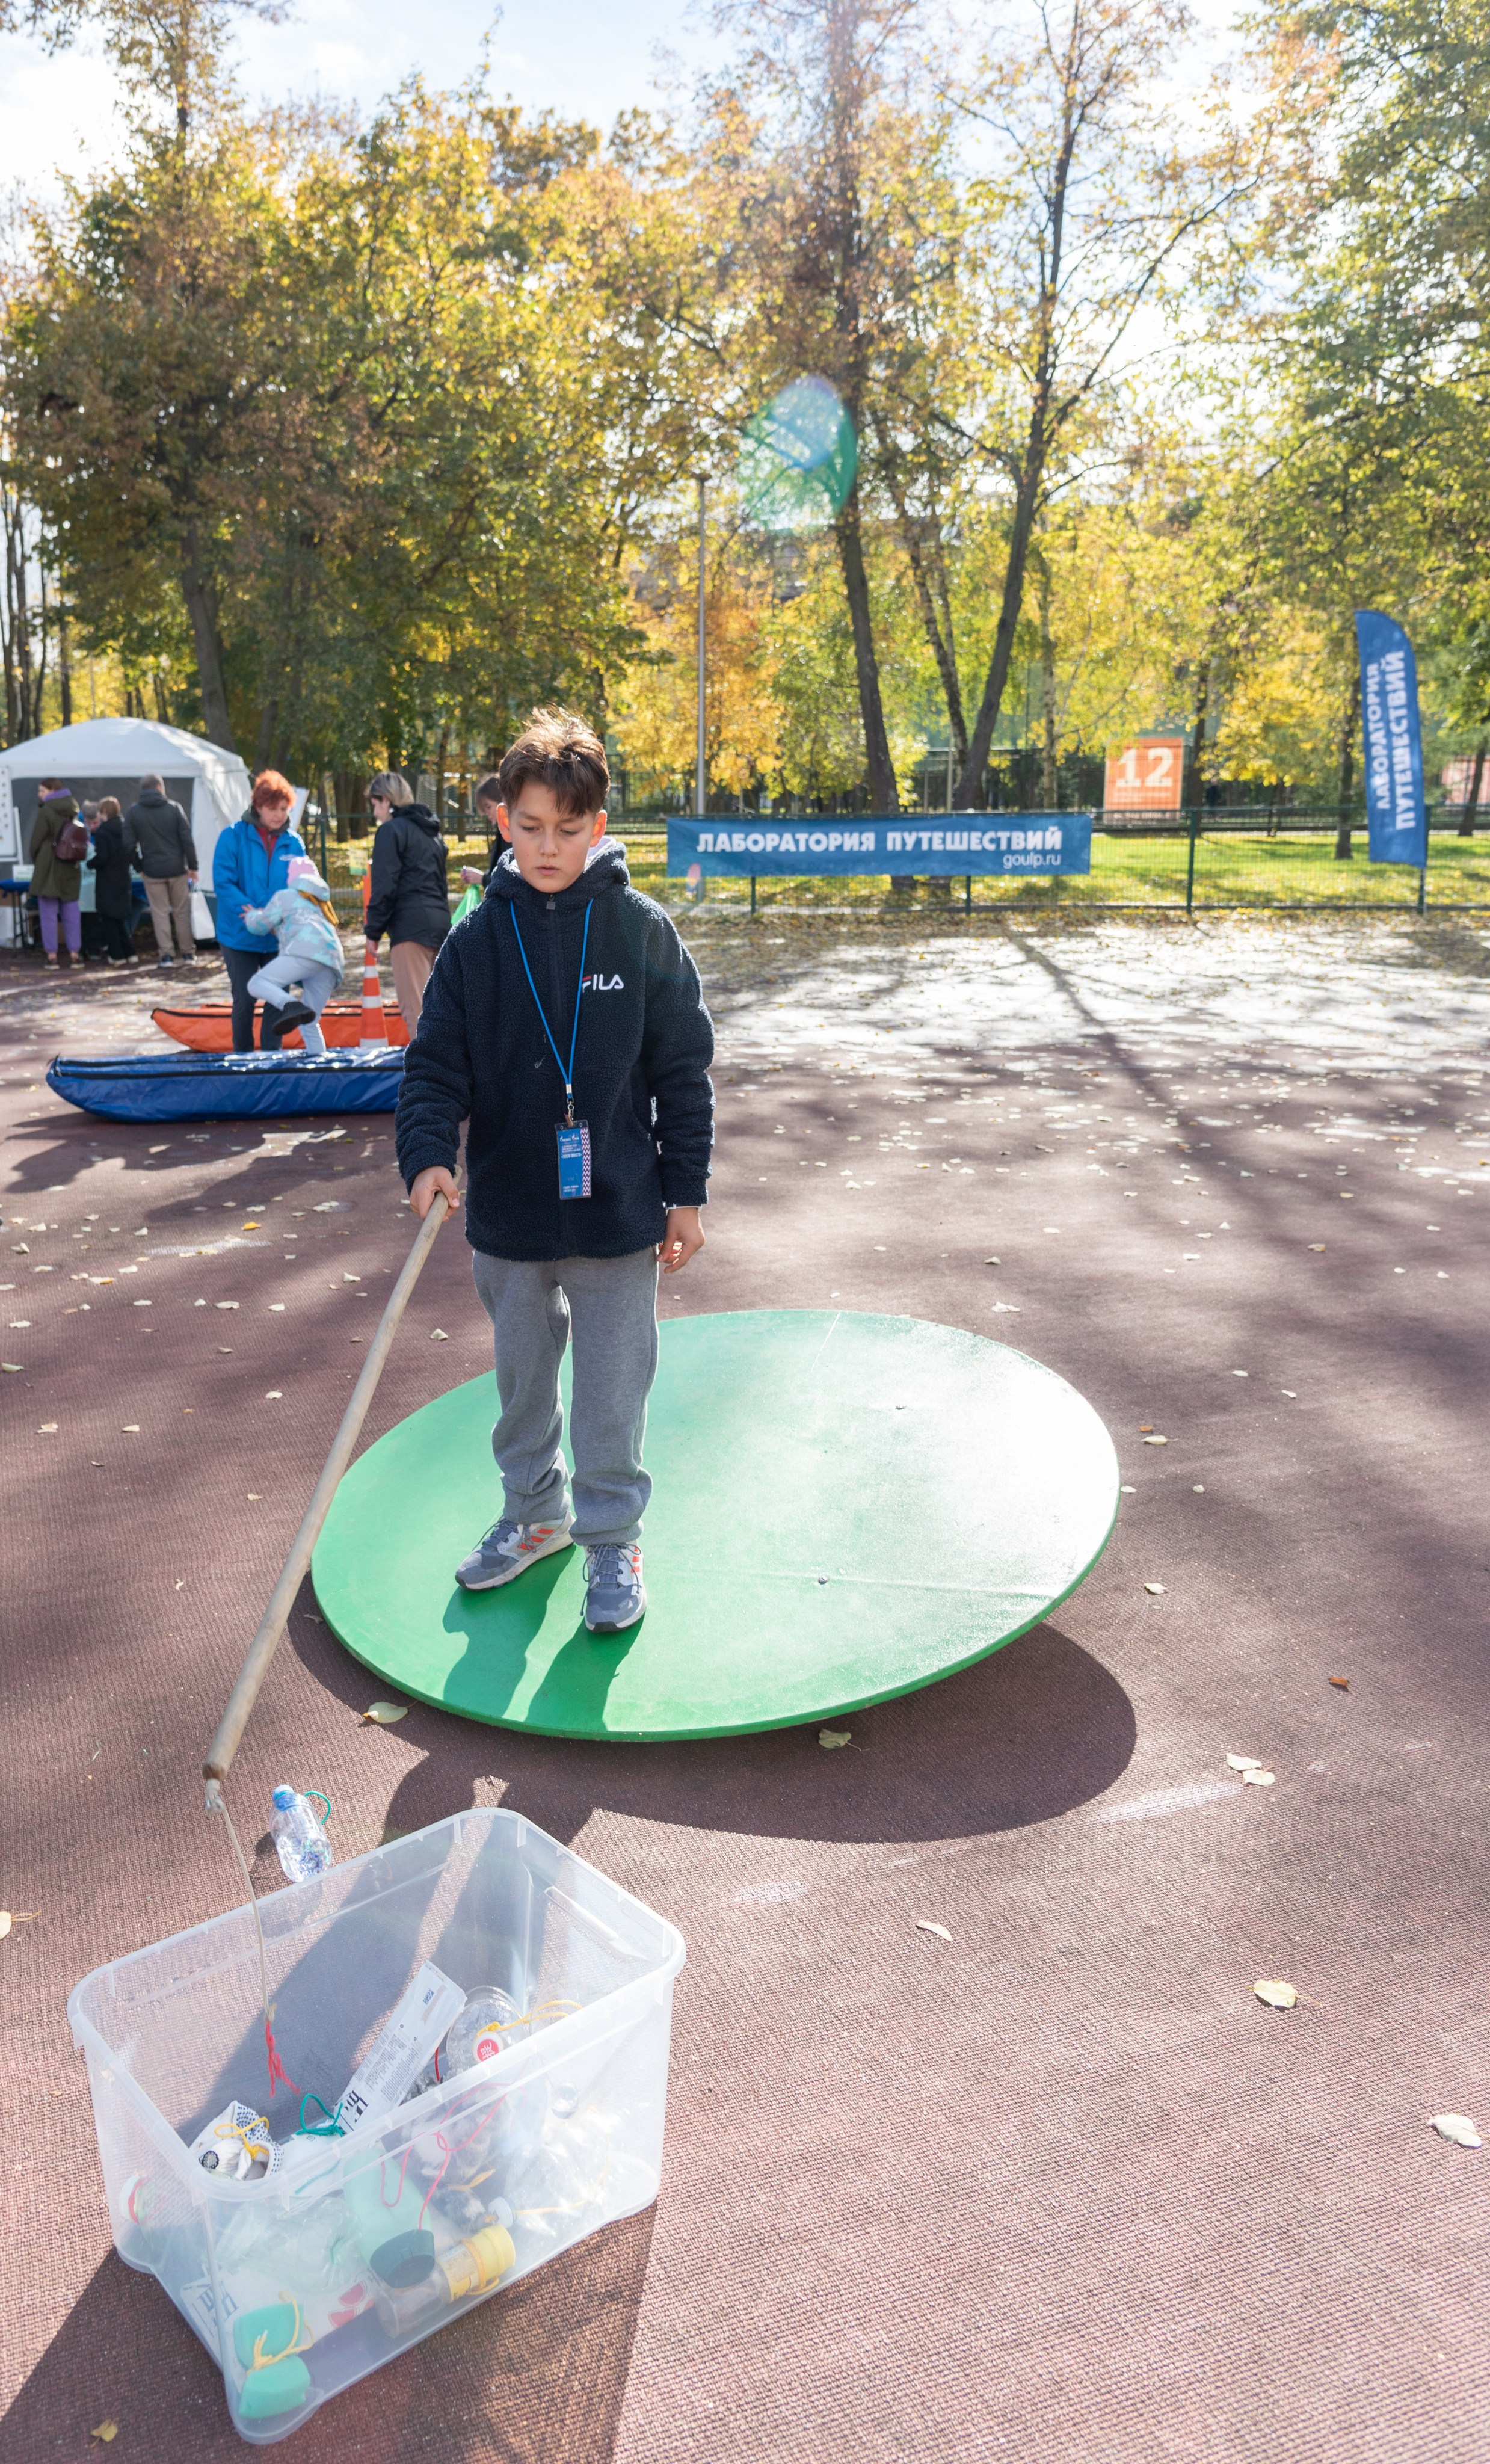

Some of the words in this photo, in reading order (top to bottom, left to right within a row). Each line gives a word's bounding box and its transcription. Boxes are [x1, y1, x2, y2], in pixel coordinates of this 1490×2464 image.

[1380, 651, 1415, 830] ПУТЕШЕСТВИЙ
[1116, 746, 1174, 787] 12
[697, 832, 875, 852] ЛАБОРАТОРИЯ
[887, 826, 1062, 851] ПУТЕШЕСТВИЙ
[1003, 852, 1062, 869] goulp.ru
[582, 973, 624, 993] FILA
